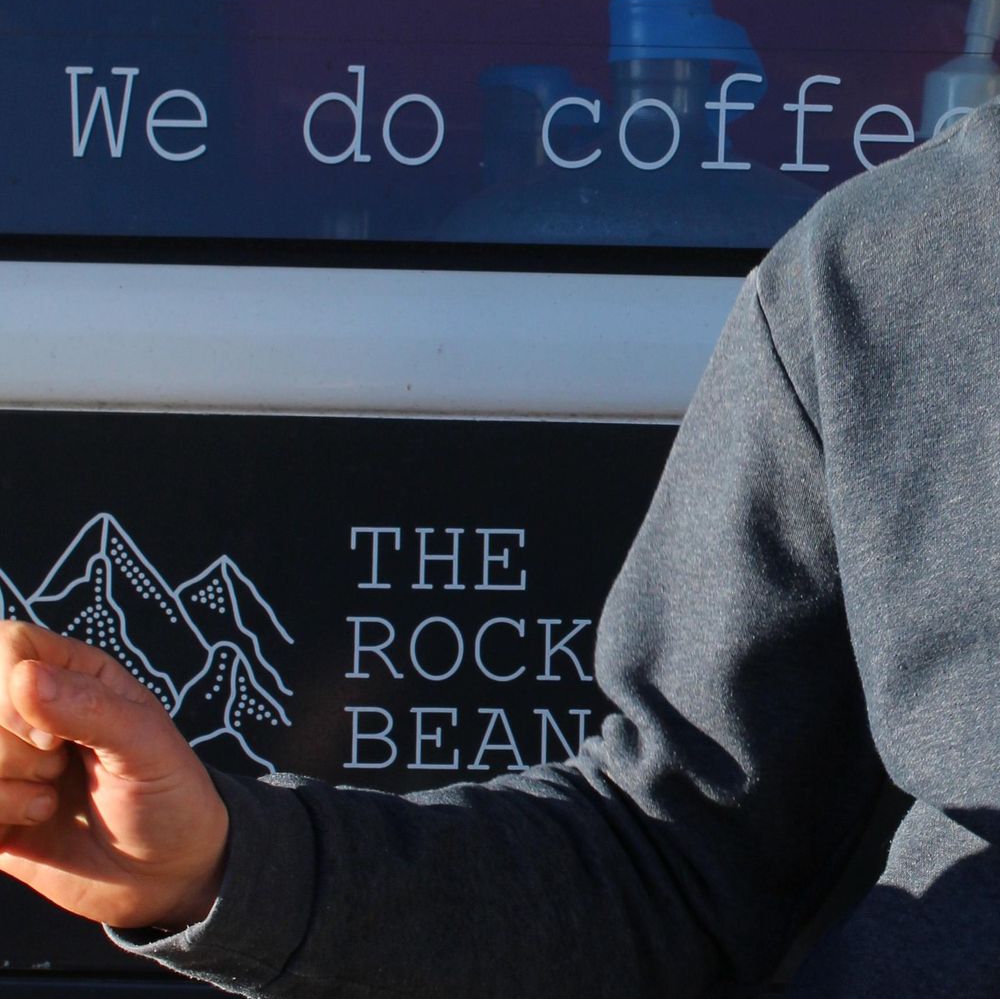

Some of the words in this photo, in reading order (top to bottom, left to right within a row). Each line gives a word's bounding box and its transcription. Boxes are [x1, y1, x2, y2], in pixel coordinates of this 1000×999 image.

[66, 66, 208, 160] We
[304, 65, 444, 165] do
[350, 527, 526, 590] THE
[345, 616, 593, 681] ROCK
[343, 706, 592, 770] BEAN
